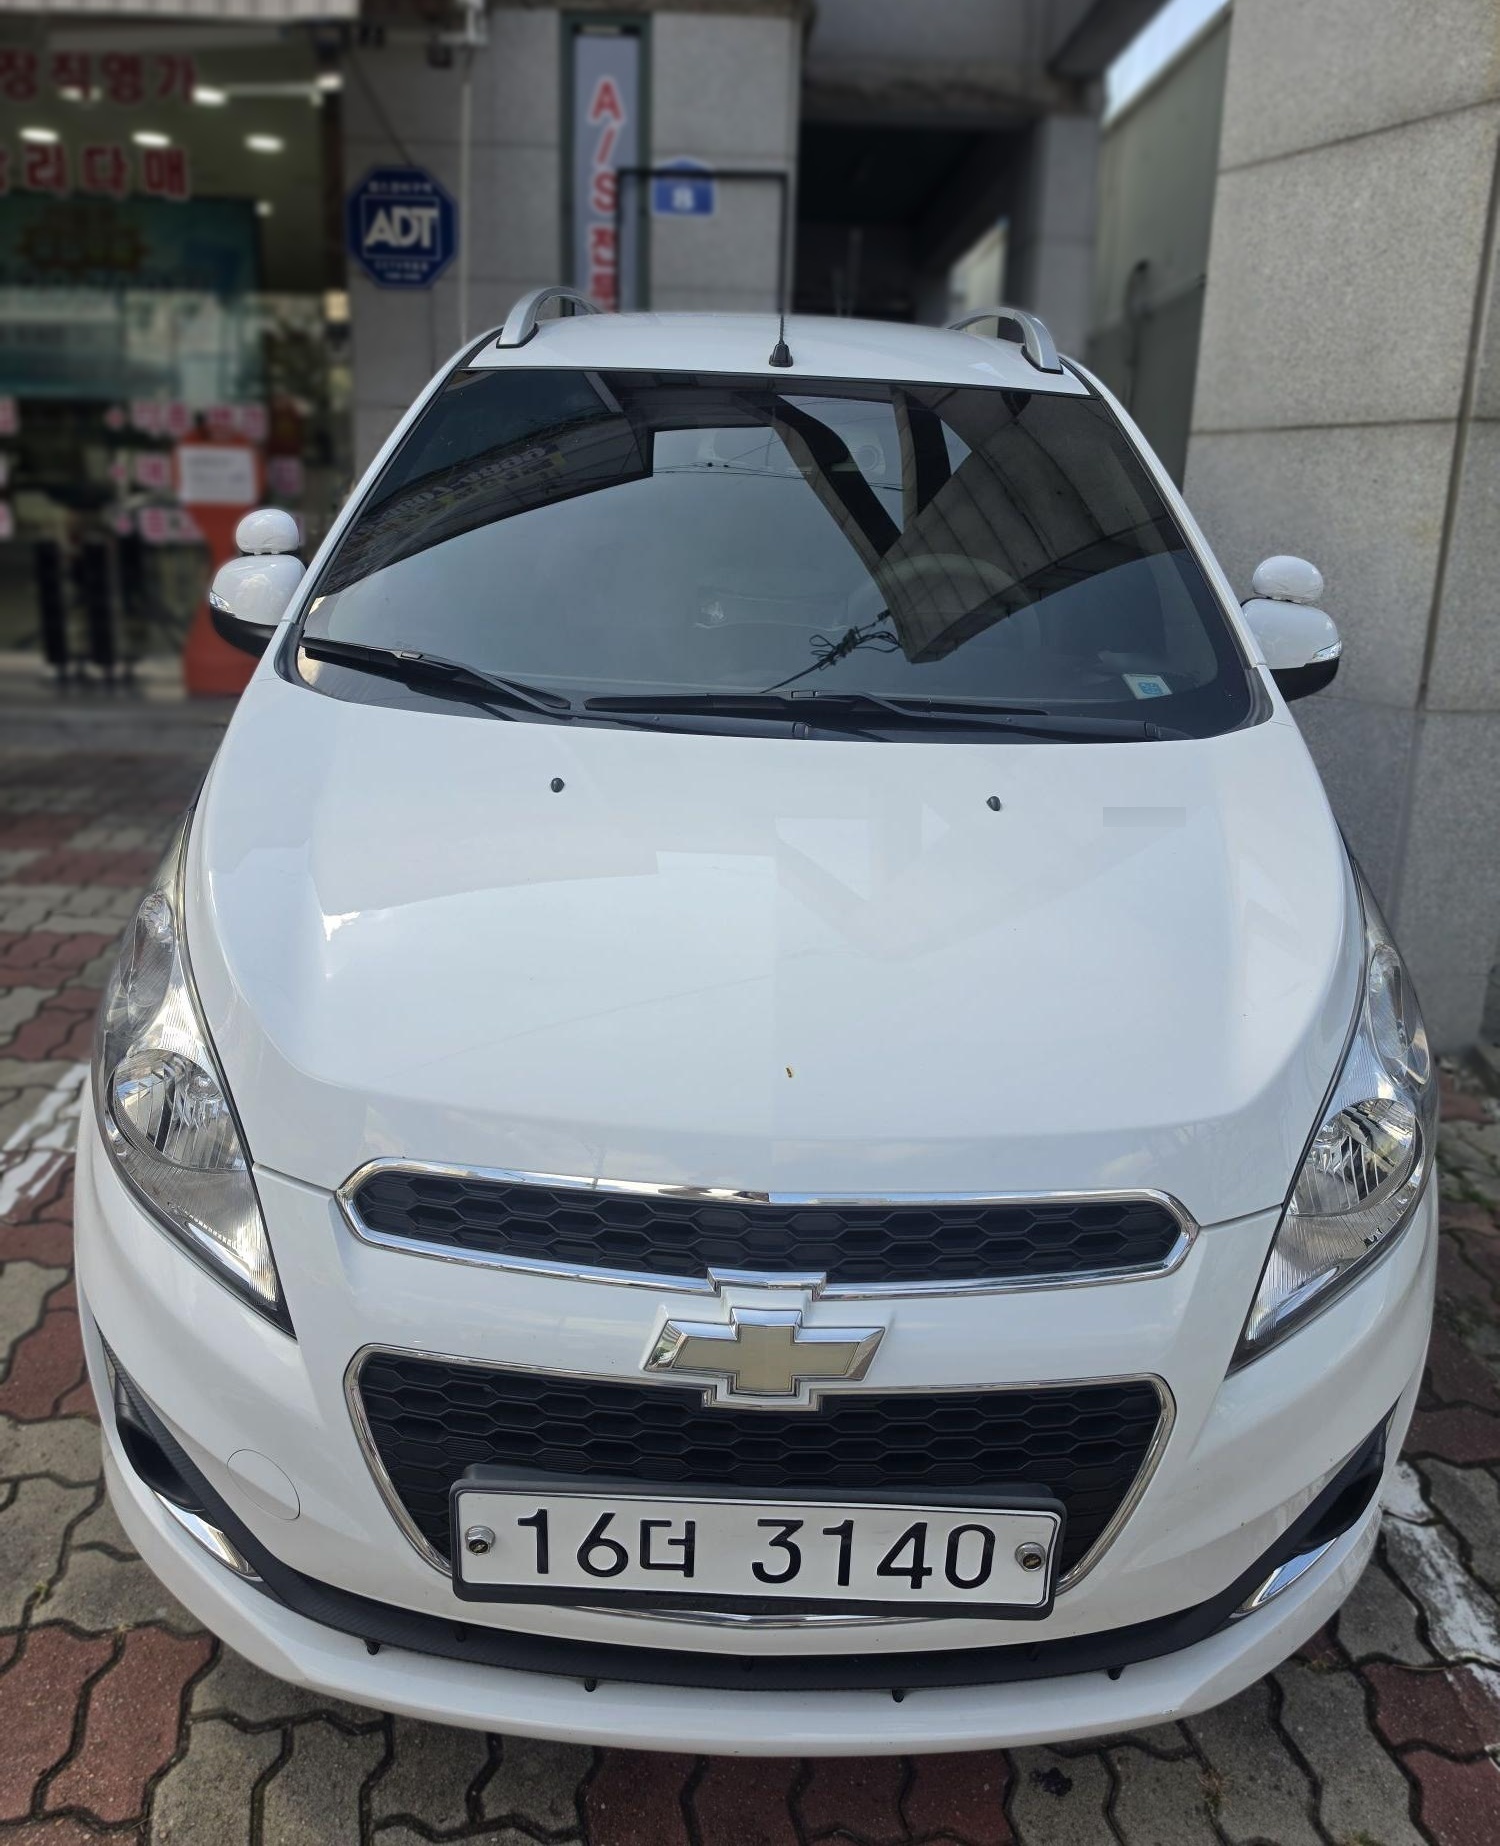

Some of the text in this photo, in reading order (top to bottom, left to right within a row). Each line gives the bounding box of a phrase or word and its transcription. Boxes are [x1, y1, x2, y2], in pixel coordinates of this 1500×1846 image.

[0, 144, 189, 198] 리다매
[364, 206, 439, 249] ADT
[516, 1507, 997, 1590] 16더 3140
